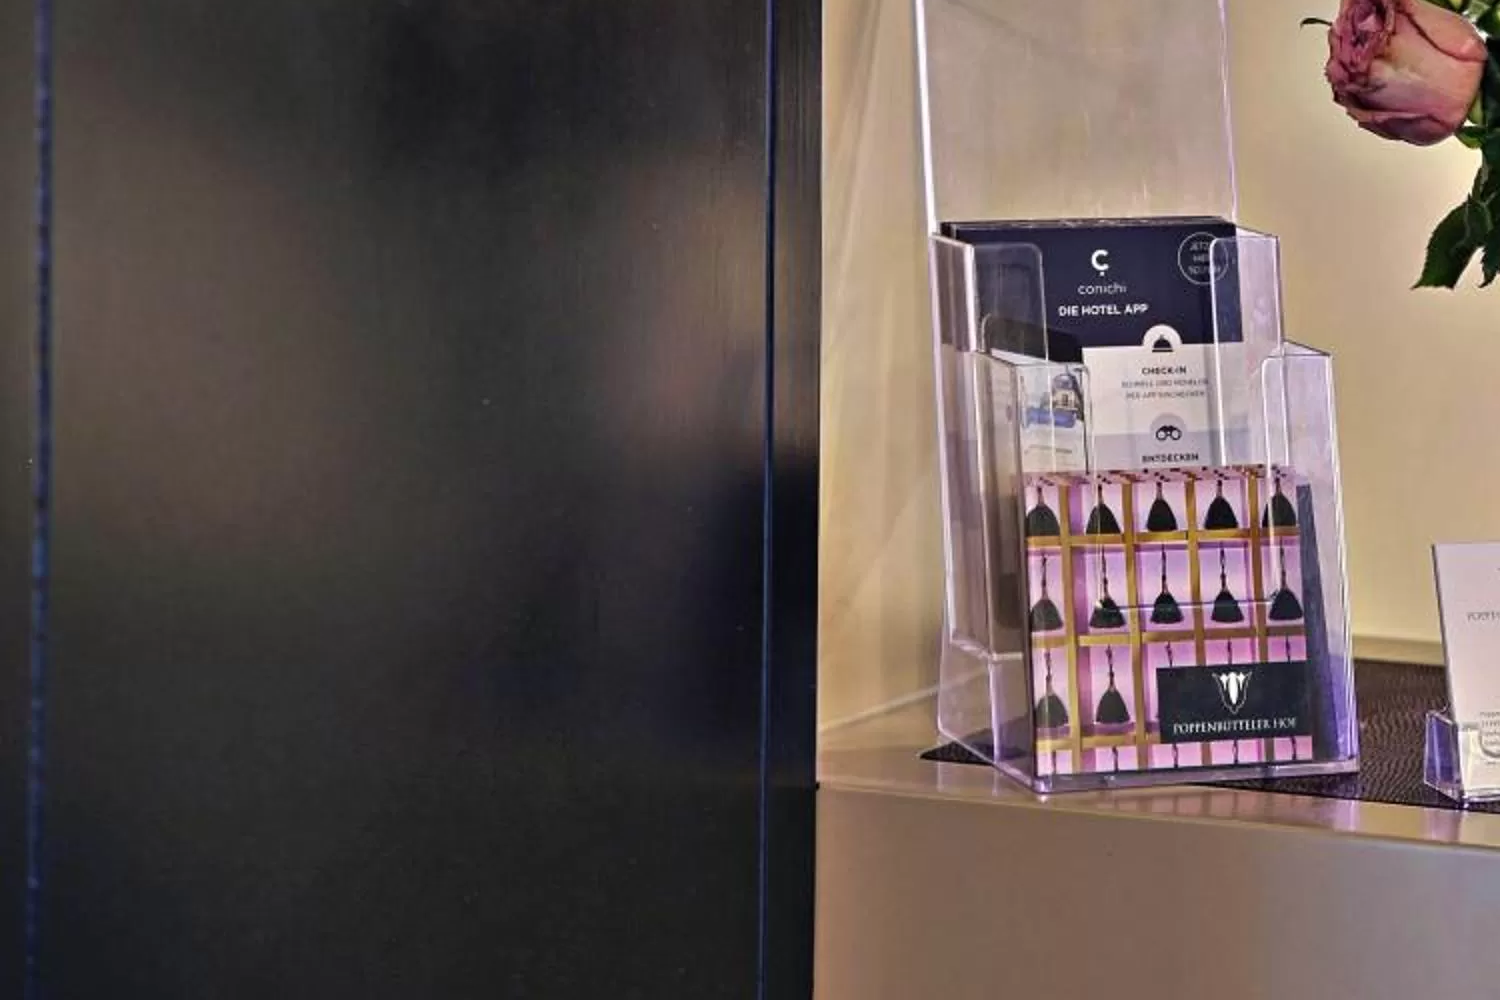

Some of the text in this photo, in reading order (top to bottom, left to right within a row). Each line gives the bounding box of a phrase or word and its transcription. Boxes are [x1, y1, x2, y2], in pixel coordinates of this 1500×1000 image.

[1077, 282, 1127, 295] conichi
[1058, 302, 1149, 317] DIE HOTEL APP
[1141, 366, 1187, 375] CHECK-IN
